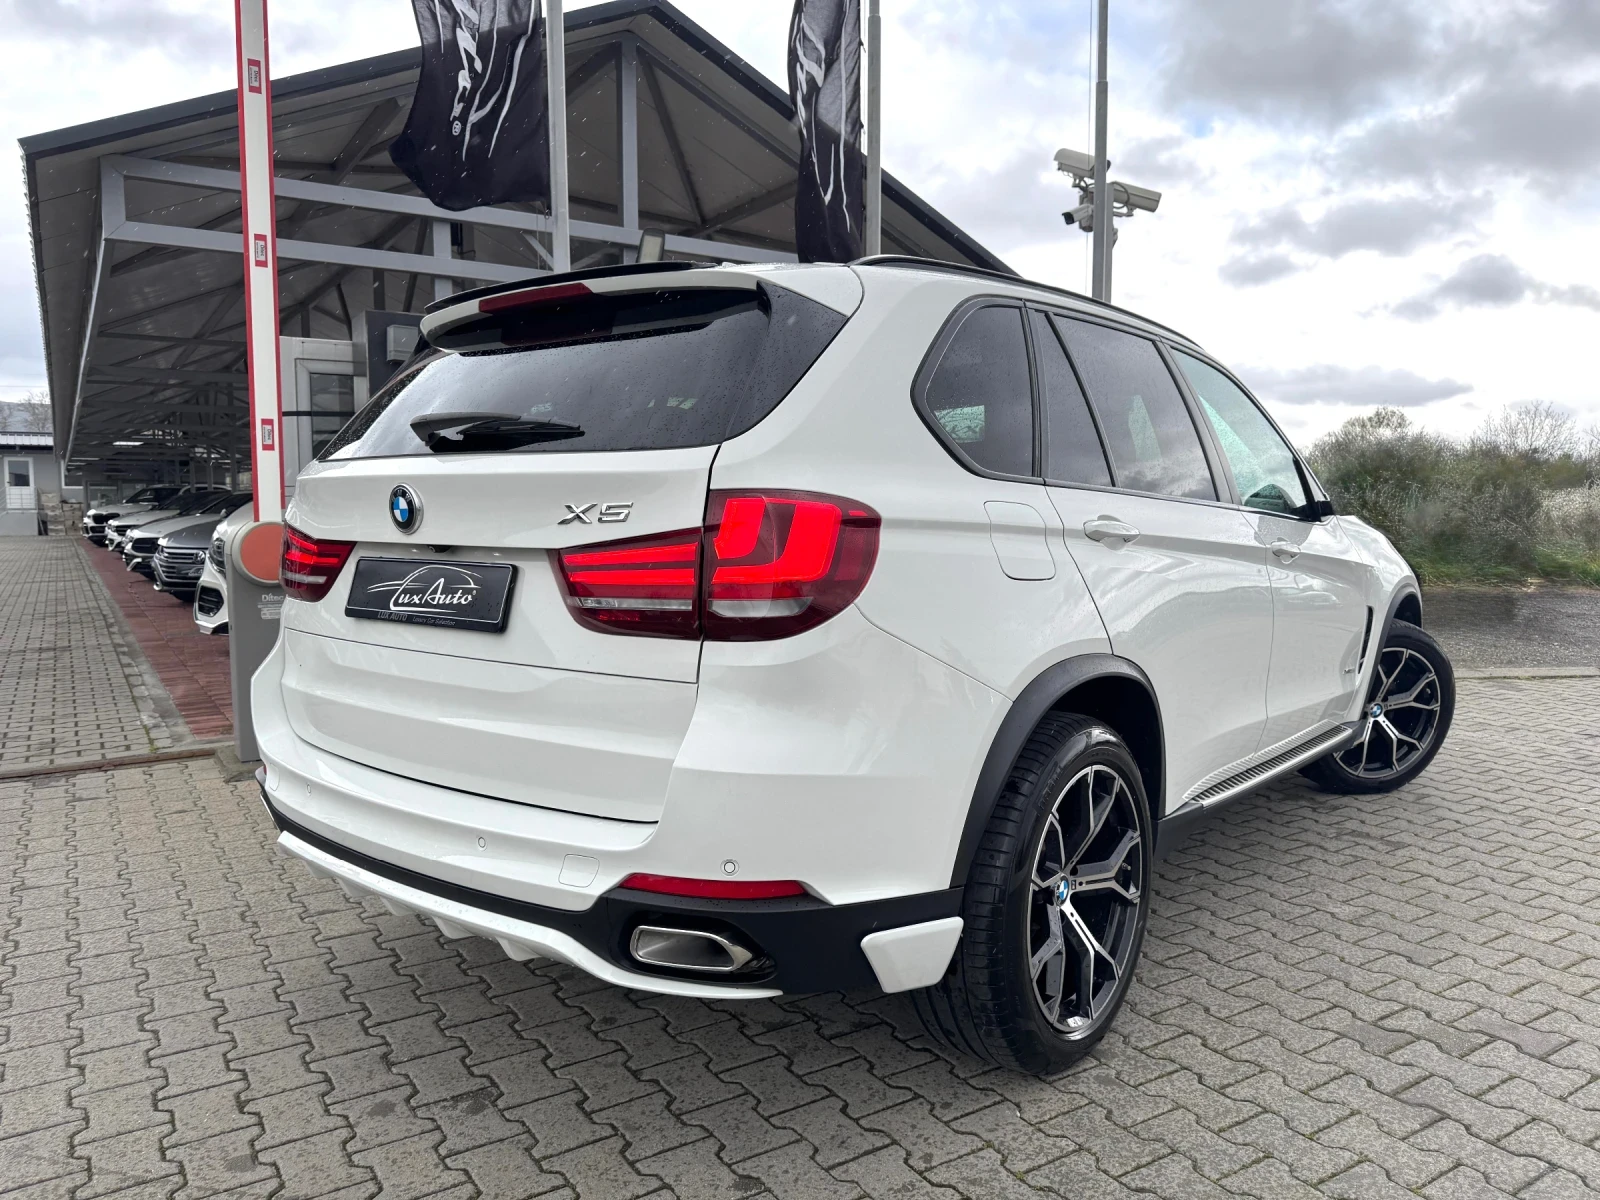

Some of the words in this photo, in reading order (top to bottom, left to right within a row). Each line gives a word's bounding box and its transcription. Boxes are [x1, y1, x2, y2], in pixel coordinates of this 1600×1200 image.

[557, 501, 634, 525] X5
[378, 610, 391, 620] LUX
[390, 612, 408, 622] AUTO
